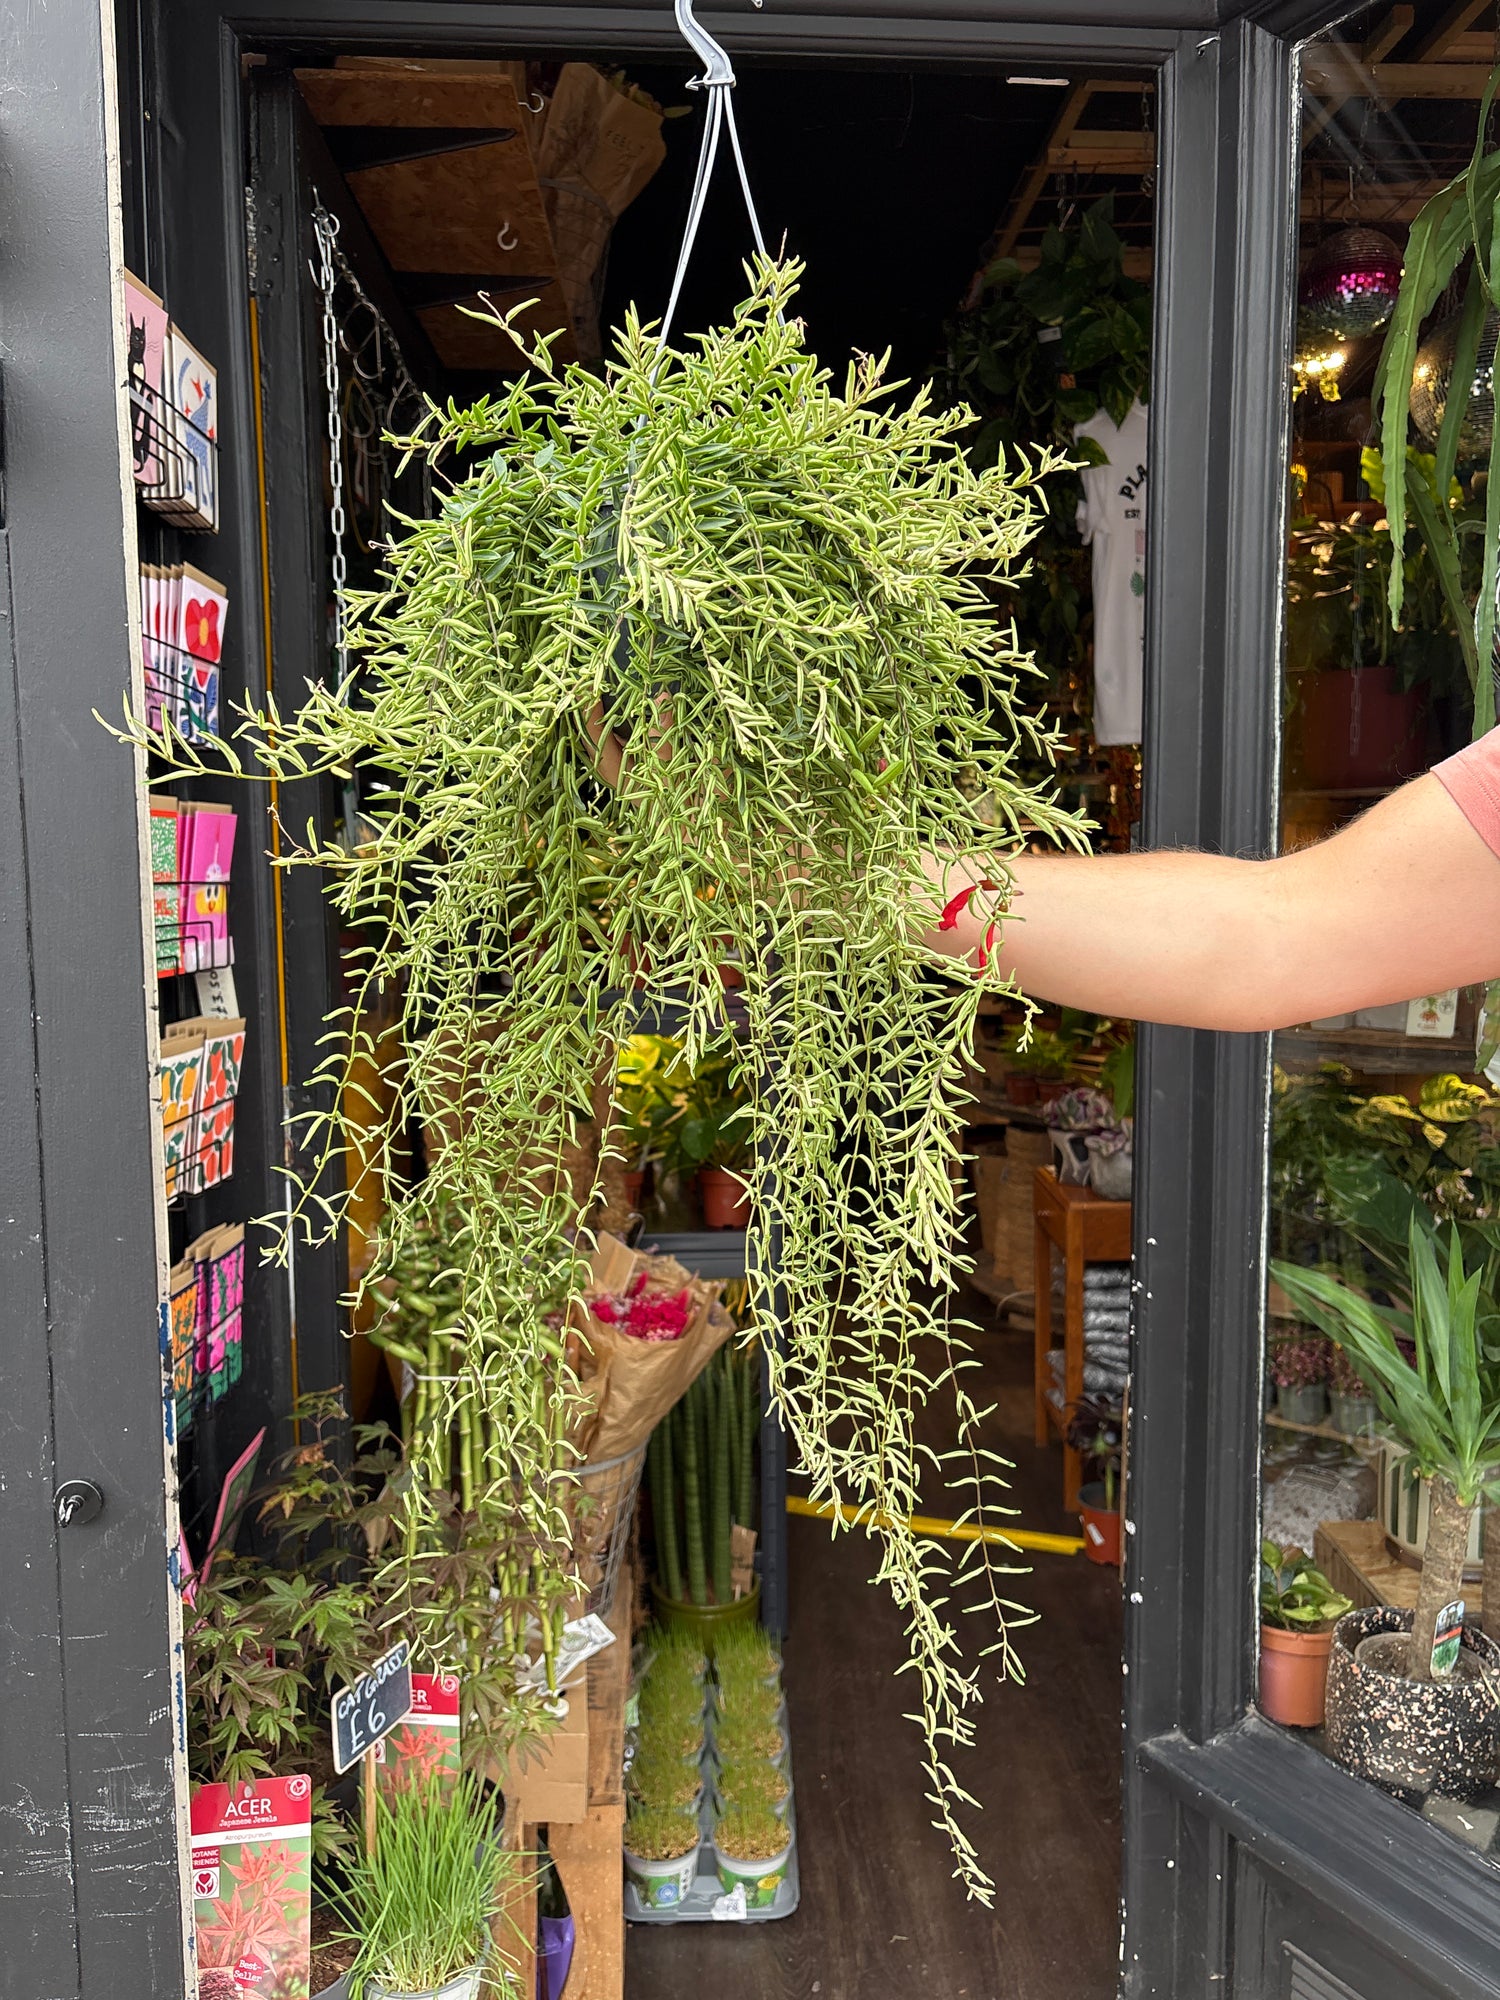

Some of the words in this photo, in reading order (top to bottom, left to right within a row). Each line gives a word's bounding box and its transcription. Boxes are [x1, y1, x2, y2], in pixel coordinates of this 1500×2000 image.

[350, 1698, 386, 1754] £6
[225, 1798, 272, 1818] ACER
[219, 1818, 252, 1828] Japanese
[253, 1815, 278, 1825] Jewels
[192, 1857, 220, 1866] RIENDS
[239, 1959, 262, 1971] Best-
[233, 1969, 262, 1982] Seller
